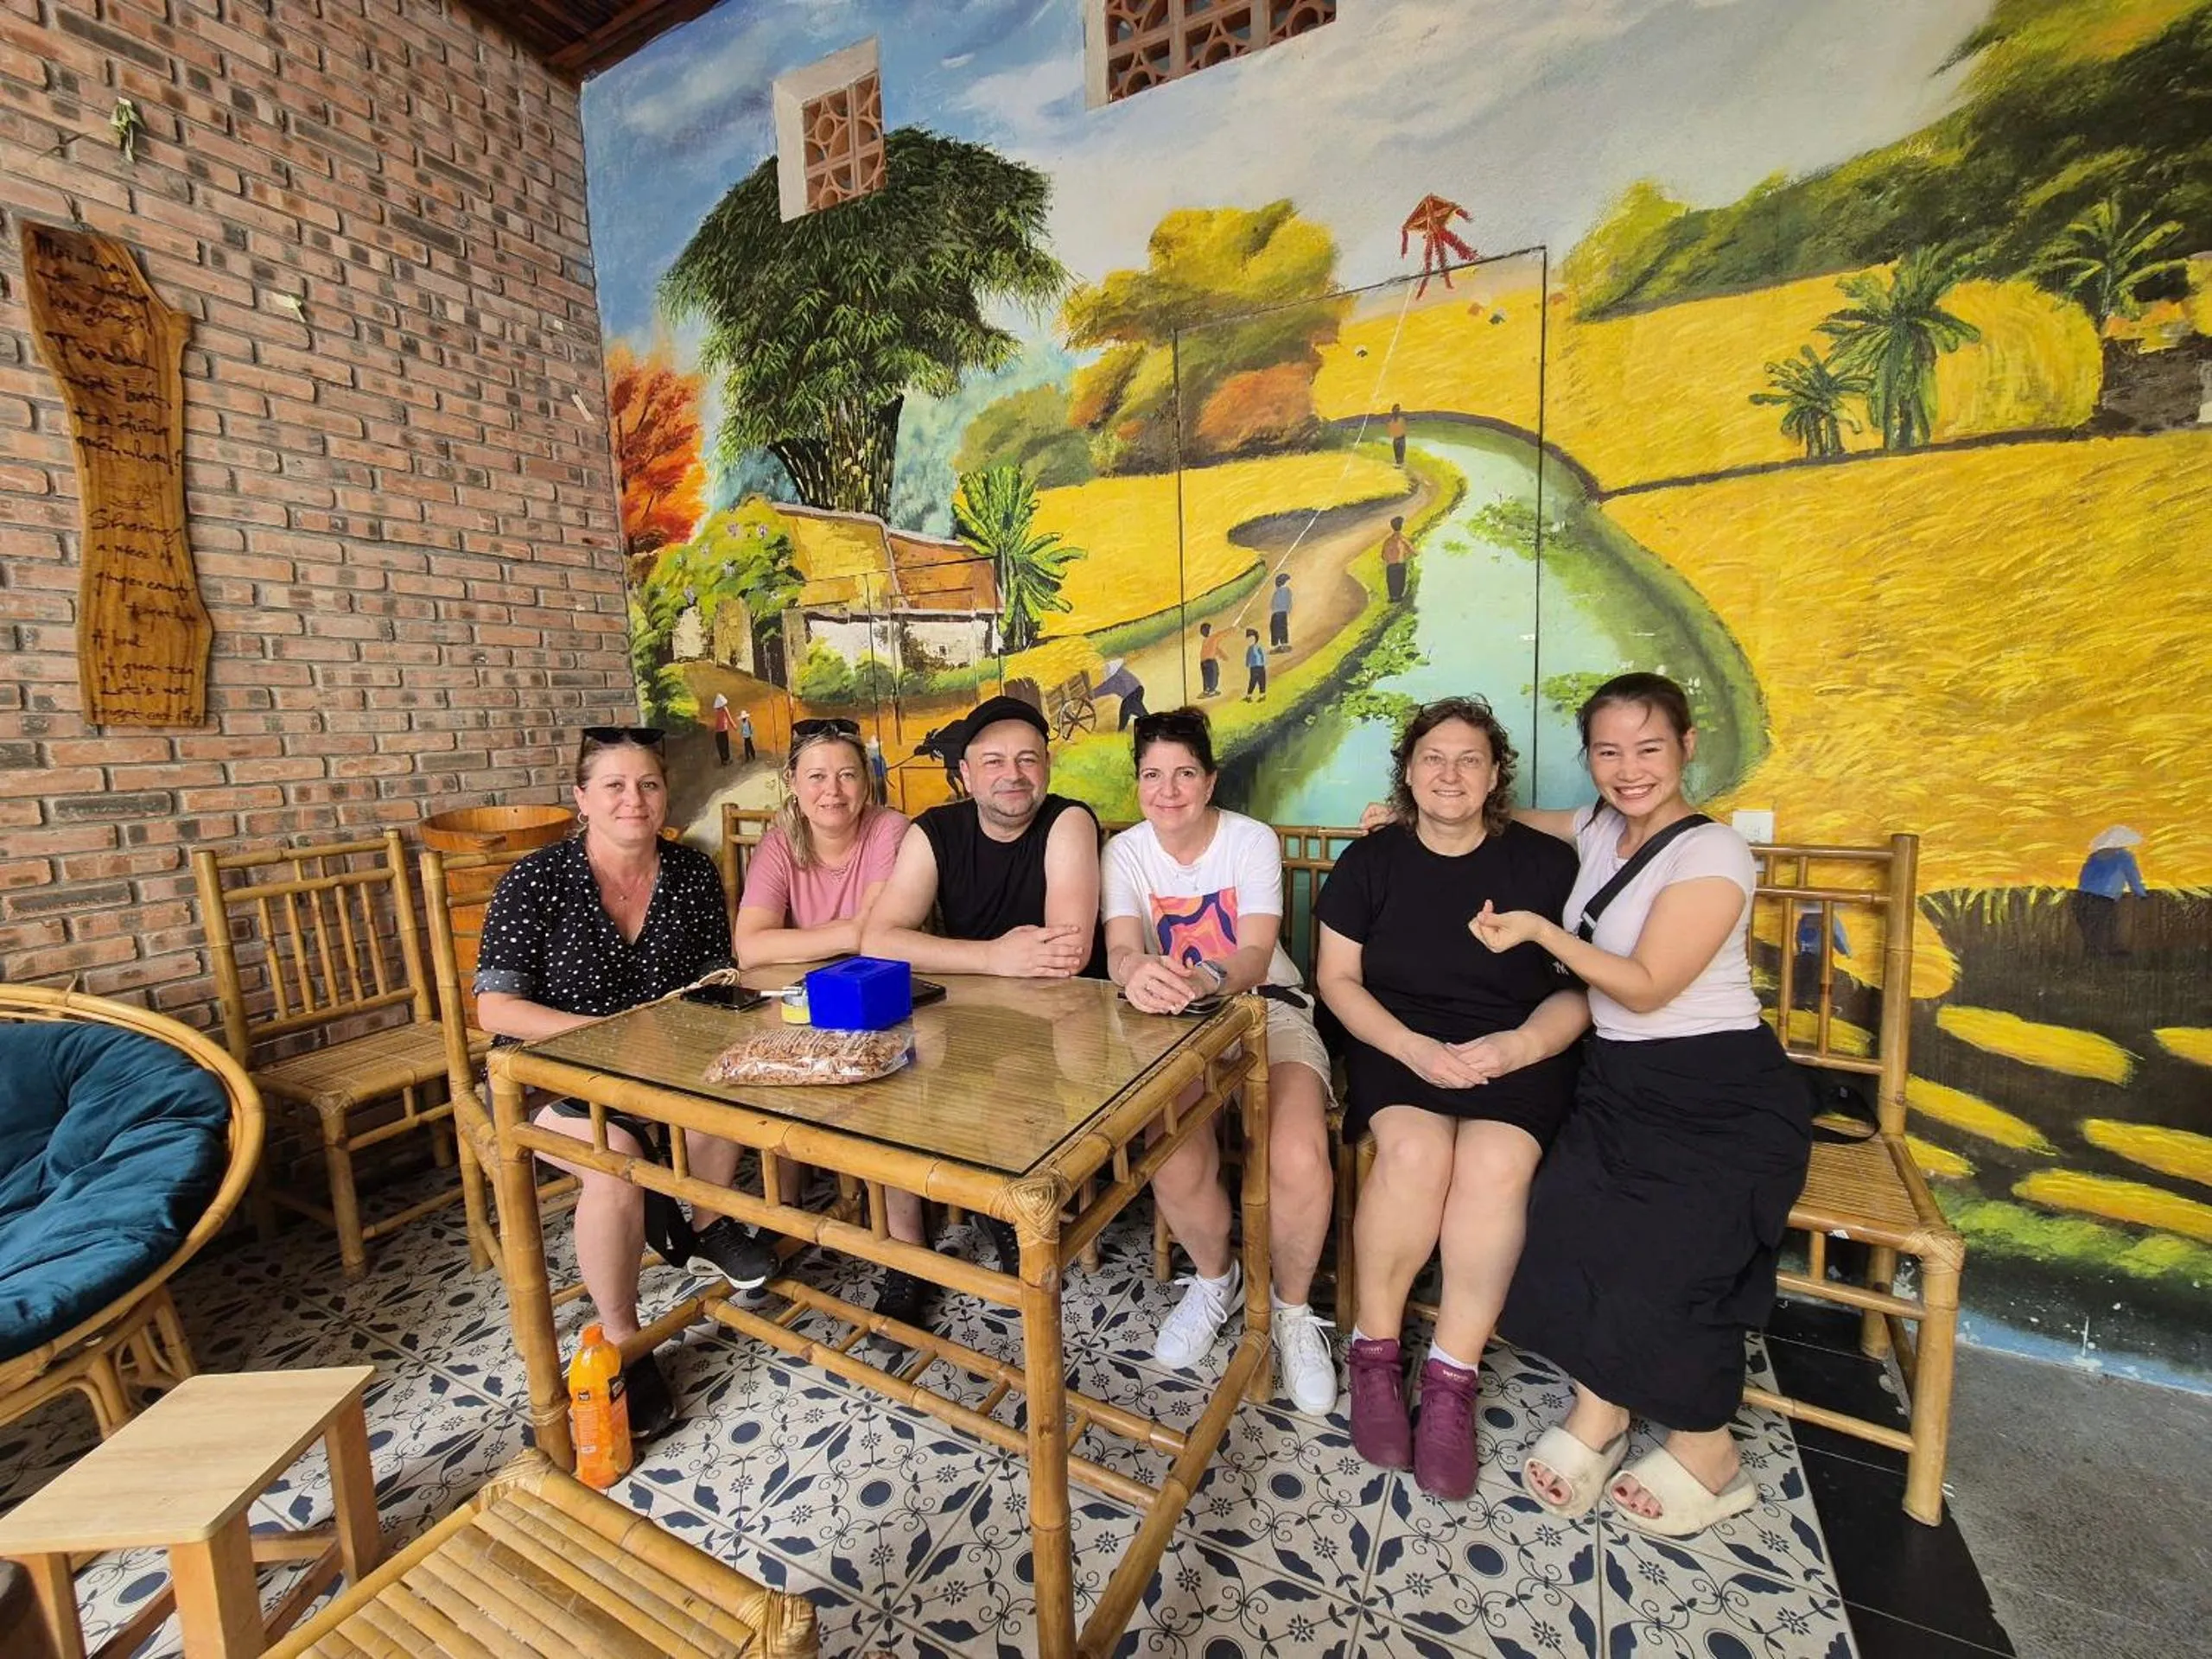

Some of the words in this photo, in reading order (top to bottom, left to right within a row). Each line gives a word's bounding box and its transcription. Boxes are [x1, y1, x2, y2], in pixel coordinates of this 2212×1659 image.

[74, 405, 113, 426] ta
[89, 507, 182, 545] Sharing
[114, 544, 149, 564] piece
[160, 544, 174, 568] of
[94, 570, 143, 601] ginger
[146, 578, 195, 601] candy
